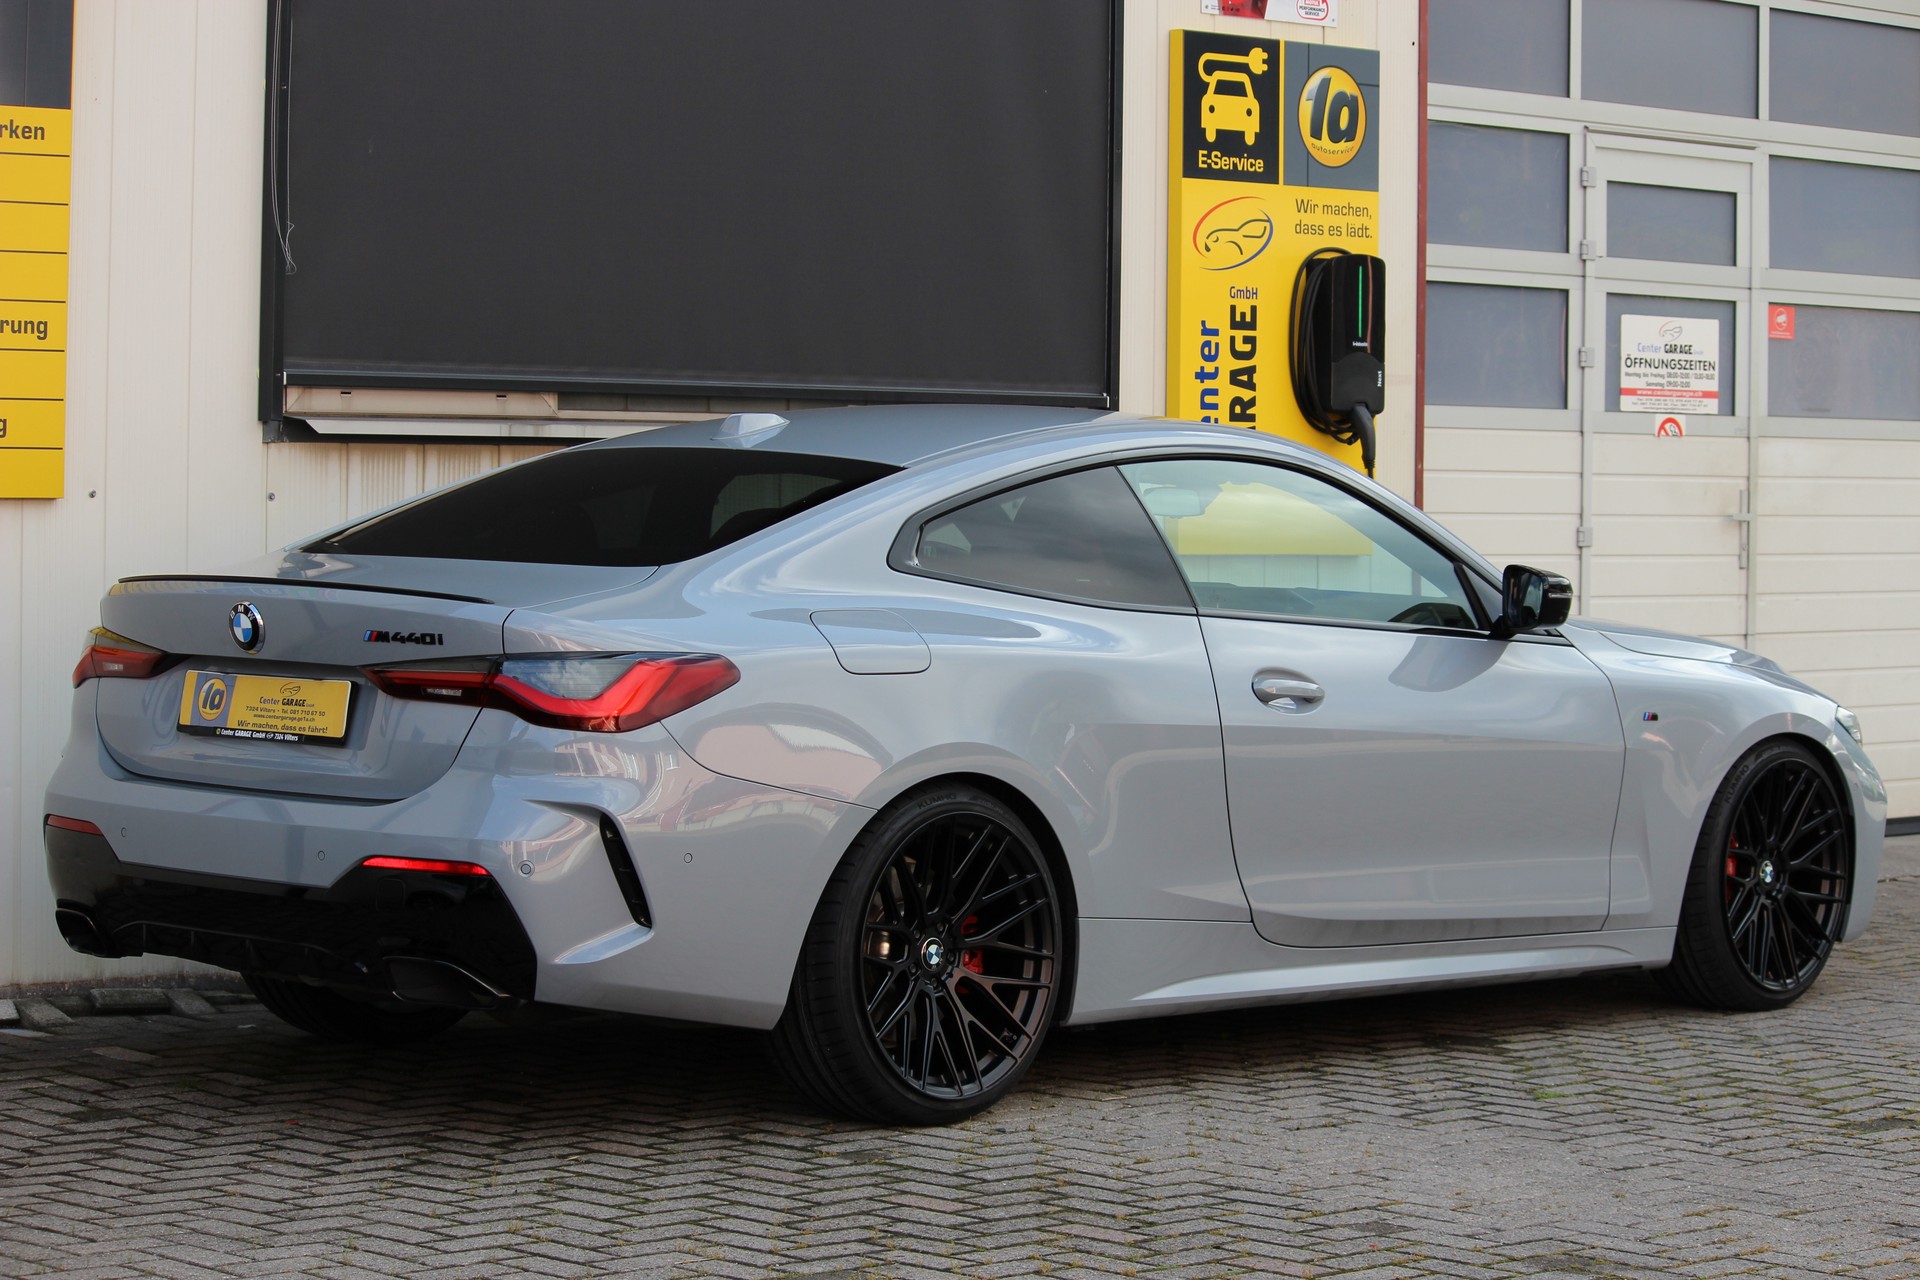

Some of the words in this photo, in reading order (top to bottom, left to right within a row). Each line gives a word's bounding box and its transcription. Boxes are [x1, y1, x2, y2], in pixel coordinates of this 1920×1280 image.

[1306, 75, 1359, 144] 1a
[1198, 150, 1264, 172] E-Service
[1295, 198, 1319, 214] Wir
[1322, 202, 1372, 220] machen,
[1294, 219, 1325, 236] dass
[1328, 224, 1343, 237] es
[1346, 222, 1373, 239] lädt.
[1229, 286, 1258, 300] GmbH
[1637, 342, 1662, 353] Center
[1663, 343, 1693, 355] GARAGE
[1229, 304, 1257, 430] RAGE
[1624, 353, 1716, 371] ÖFFNUNGSZEITEN
[377, 630, 444, 646] M440i
[202, 682, 225, 710] 1a
[259, 696, 280, 705] Center
[281, 698, 306, 707] GARAGE
[237, 719, 251, 728] Wir
[251, 721, 280, 731] machen,
[280, 723, 297, 731] dass
[308, 725, 328, 734] fährt!
[252, 731, 267, 739] GmbH
